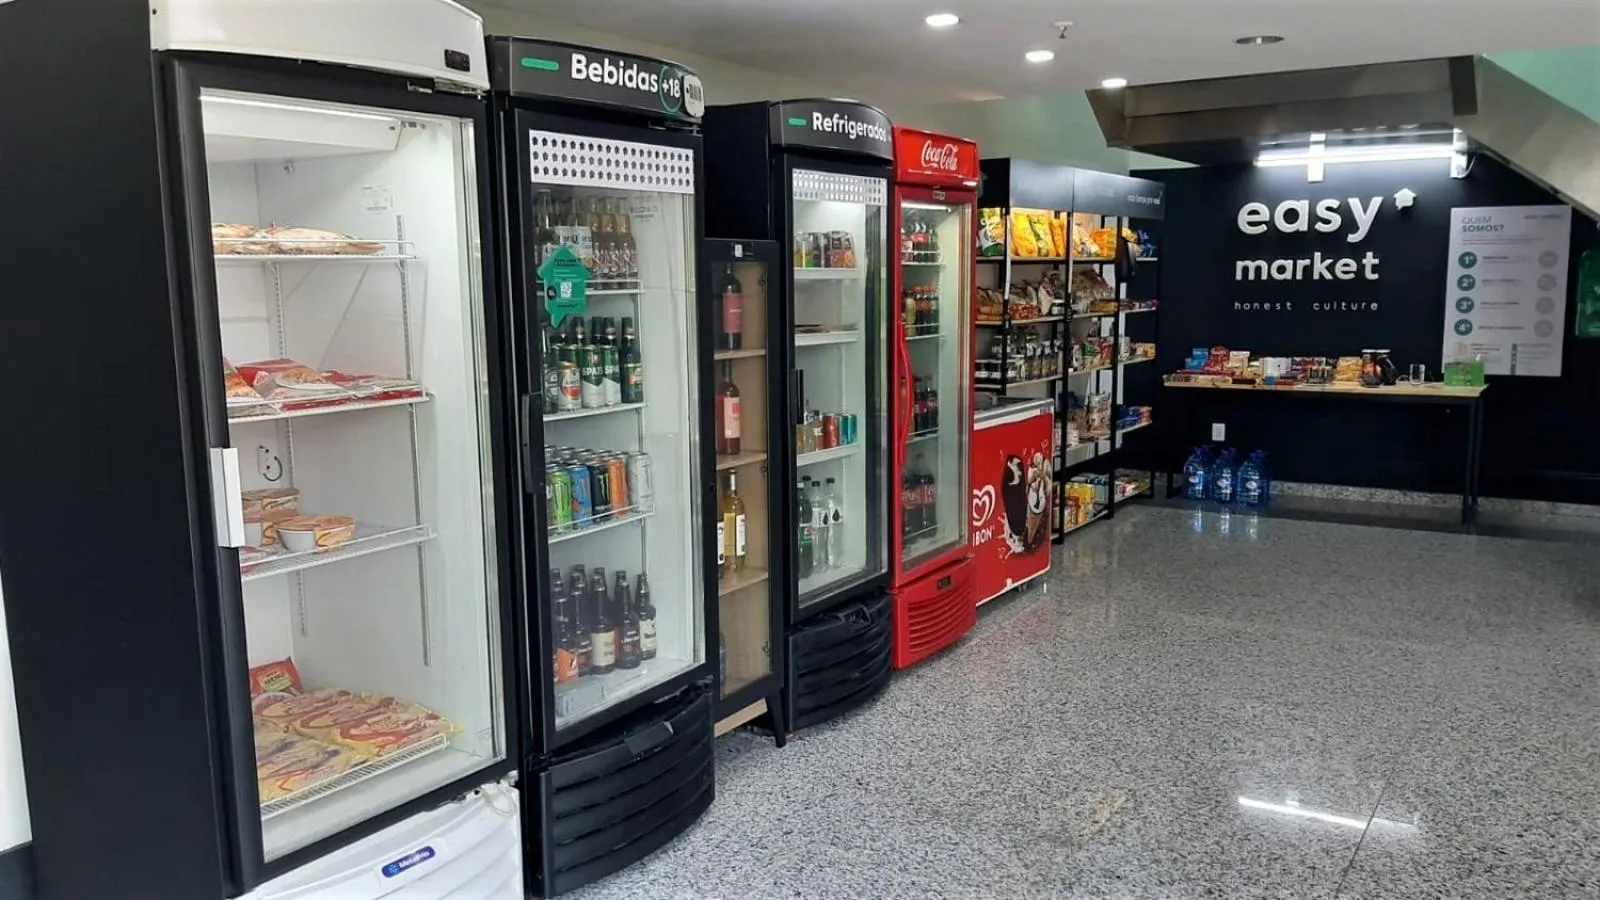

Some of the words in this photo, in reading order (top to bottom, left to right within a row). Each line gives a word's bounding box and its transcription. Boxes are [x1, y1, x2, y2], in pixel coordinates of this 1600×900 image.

[571, 53, 658, 93] Bebidas
[662, 78, 682, 98] +18
[1237, 196, 1384, 243] easy
[1462, 216, 1492, 224] QUEM
[1462, 224, 1505, 233] SOMOS?
[1235, 251, 1380, 281] market
[1234, 301, 1292, 311] honest
[1312, 301, 1379, 311] culture
[973, 529, 993, 548] IBON
